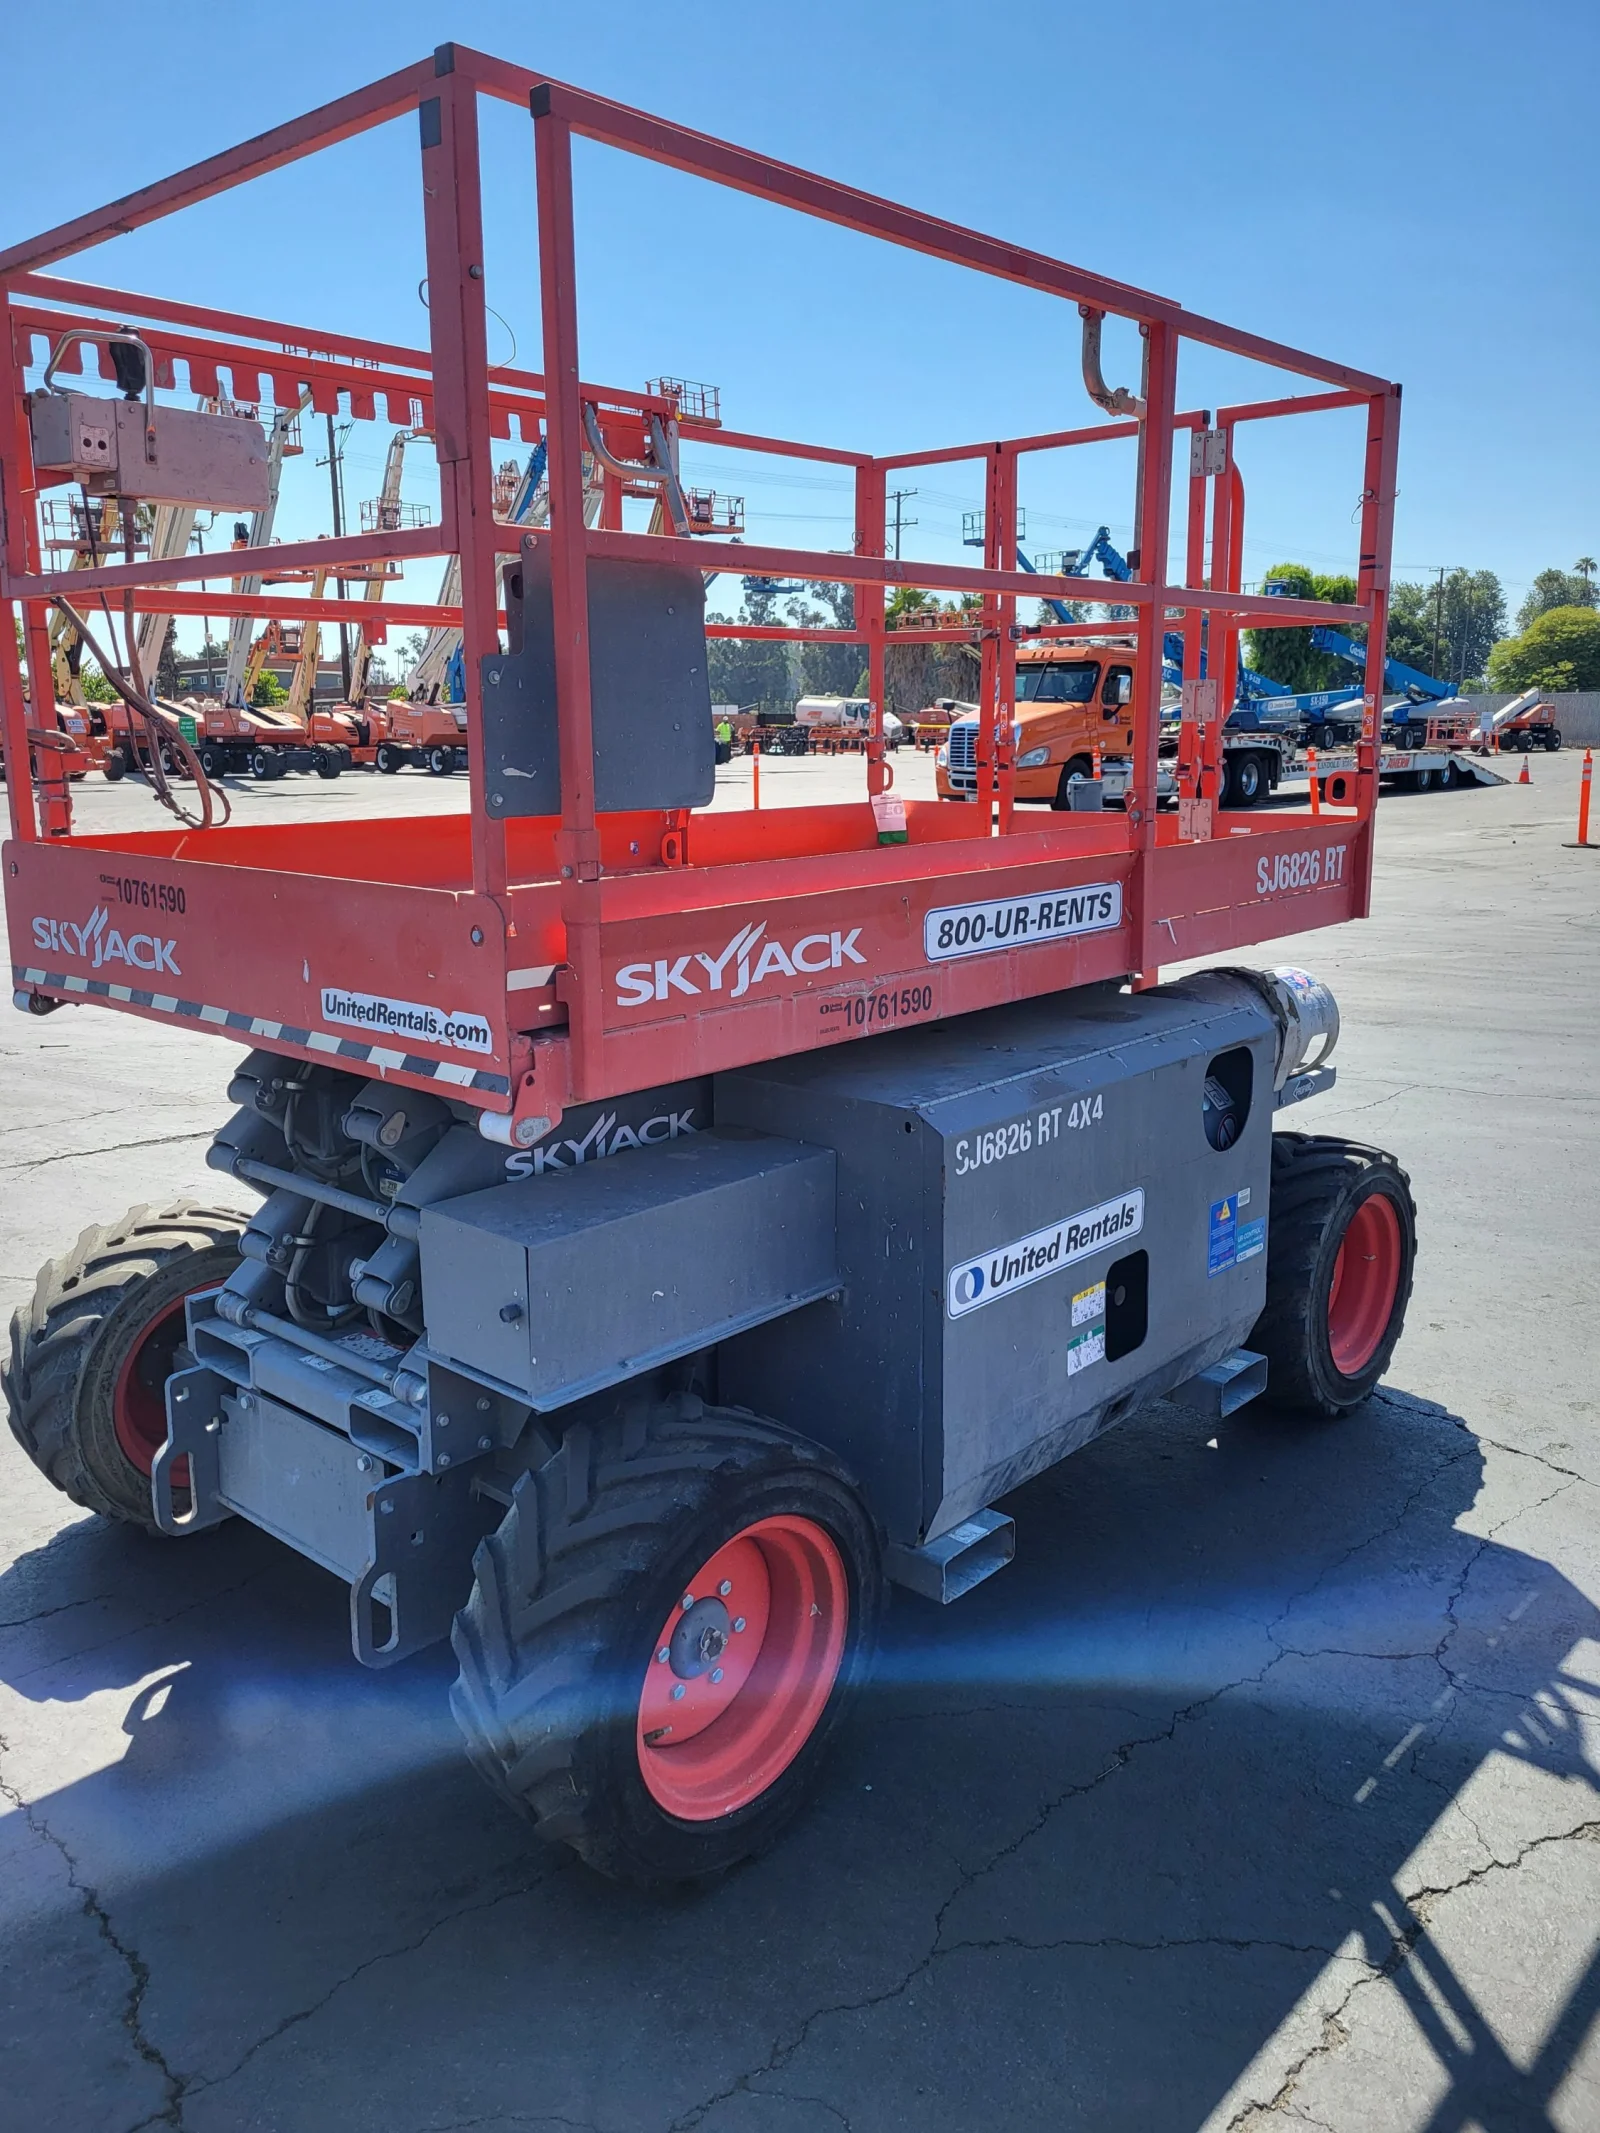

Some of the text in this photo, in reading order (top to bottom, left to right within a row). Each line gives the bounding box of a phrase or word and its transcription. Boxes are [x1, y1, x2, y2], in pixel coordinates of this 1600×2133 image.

[115, 876, 186, 914] 10761590
[1256, 844, 1347, 894] SJ6826 RT
[31, 904, 183, 976] SKYJACK
[937, 891, 1113, 949] 800-UR-RENTS
[615, 919, 868, 1007] SKYJACK
[325, 993, 488, 1045] UnitedRentals.com
[843, 985, 933, 1027] 10761590
[504, 1107, 699, 1183] SKYJACK
[955, 1093, 1104, 1176] SJ6826 RT 4X4
[990, 1202, 1136, 1289] United Rentals
